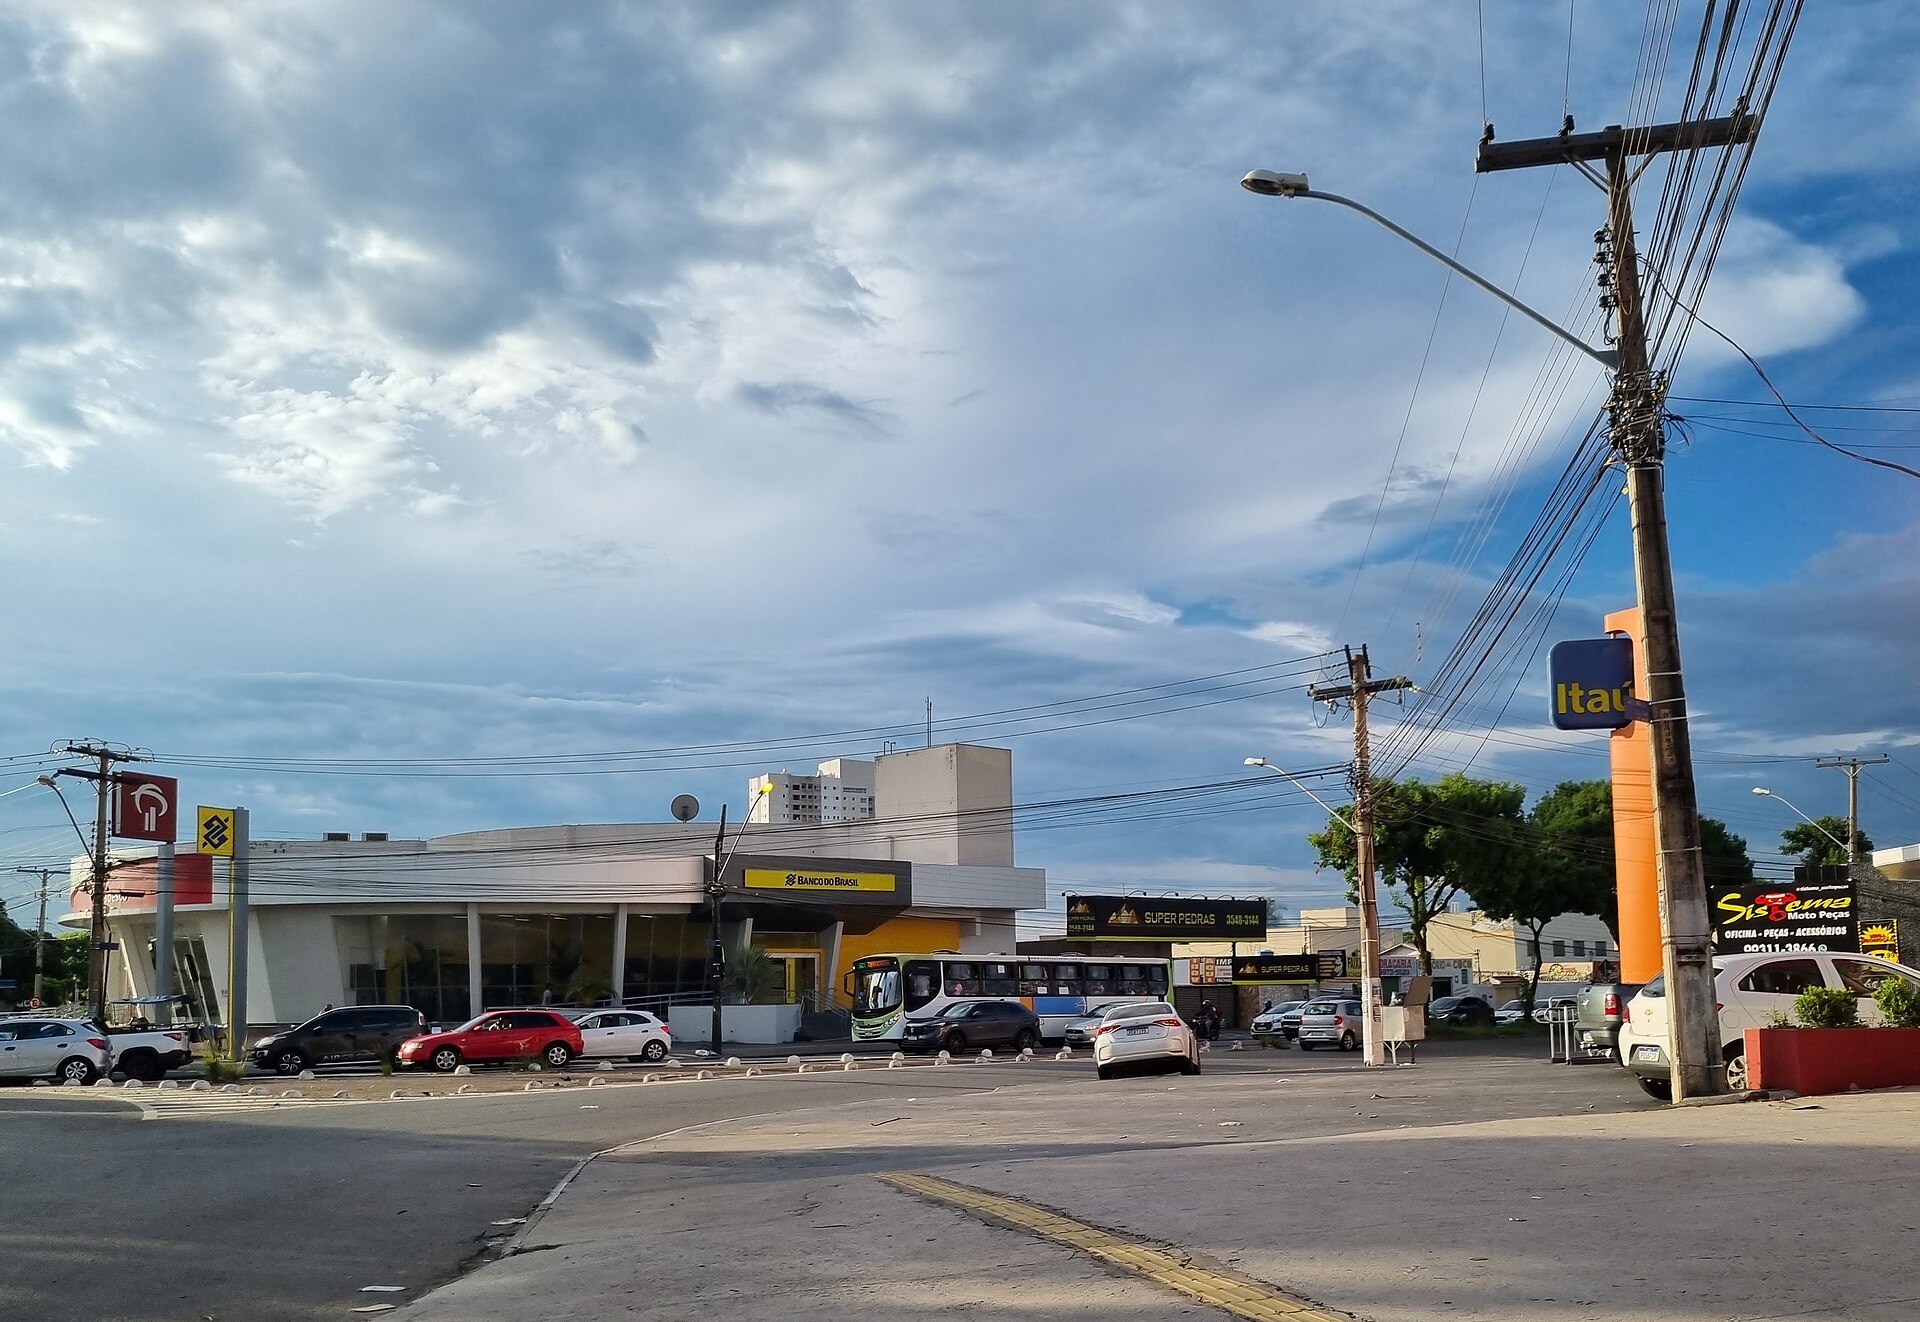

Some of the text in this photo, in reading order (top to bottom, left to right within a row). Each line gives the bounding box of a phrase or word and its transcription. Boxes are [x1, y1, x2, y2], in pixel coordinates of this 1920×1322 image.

[1557, 681, 1635, 714] Itaú
[1144, 911, 1216, 925] SUPER PEDRAS
[1226, 914, 1259, 926] 3548-3144
[1787, 910, 1851, 921] Moto Peças
[1724, 929, 1757, 939] OFICINA
[1763, 927, 1789, 939] PEÇAS
[1795, 924, 1847, 937] ACESSÓRIOS
[1261, 964, 1310, 973] SUPER PEDRAS
